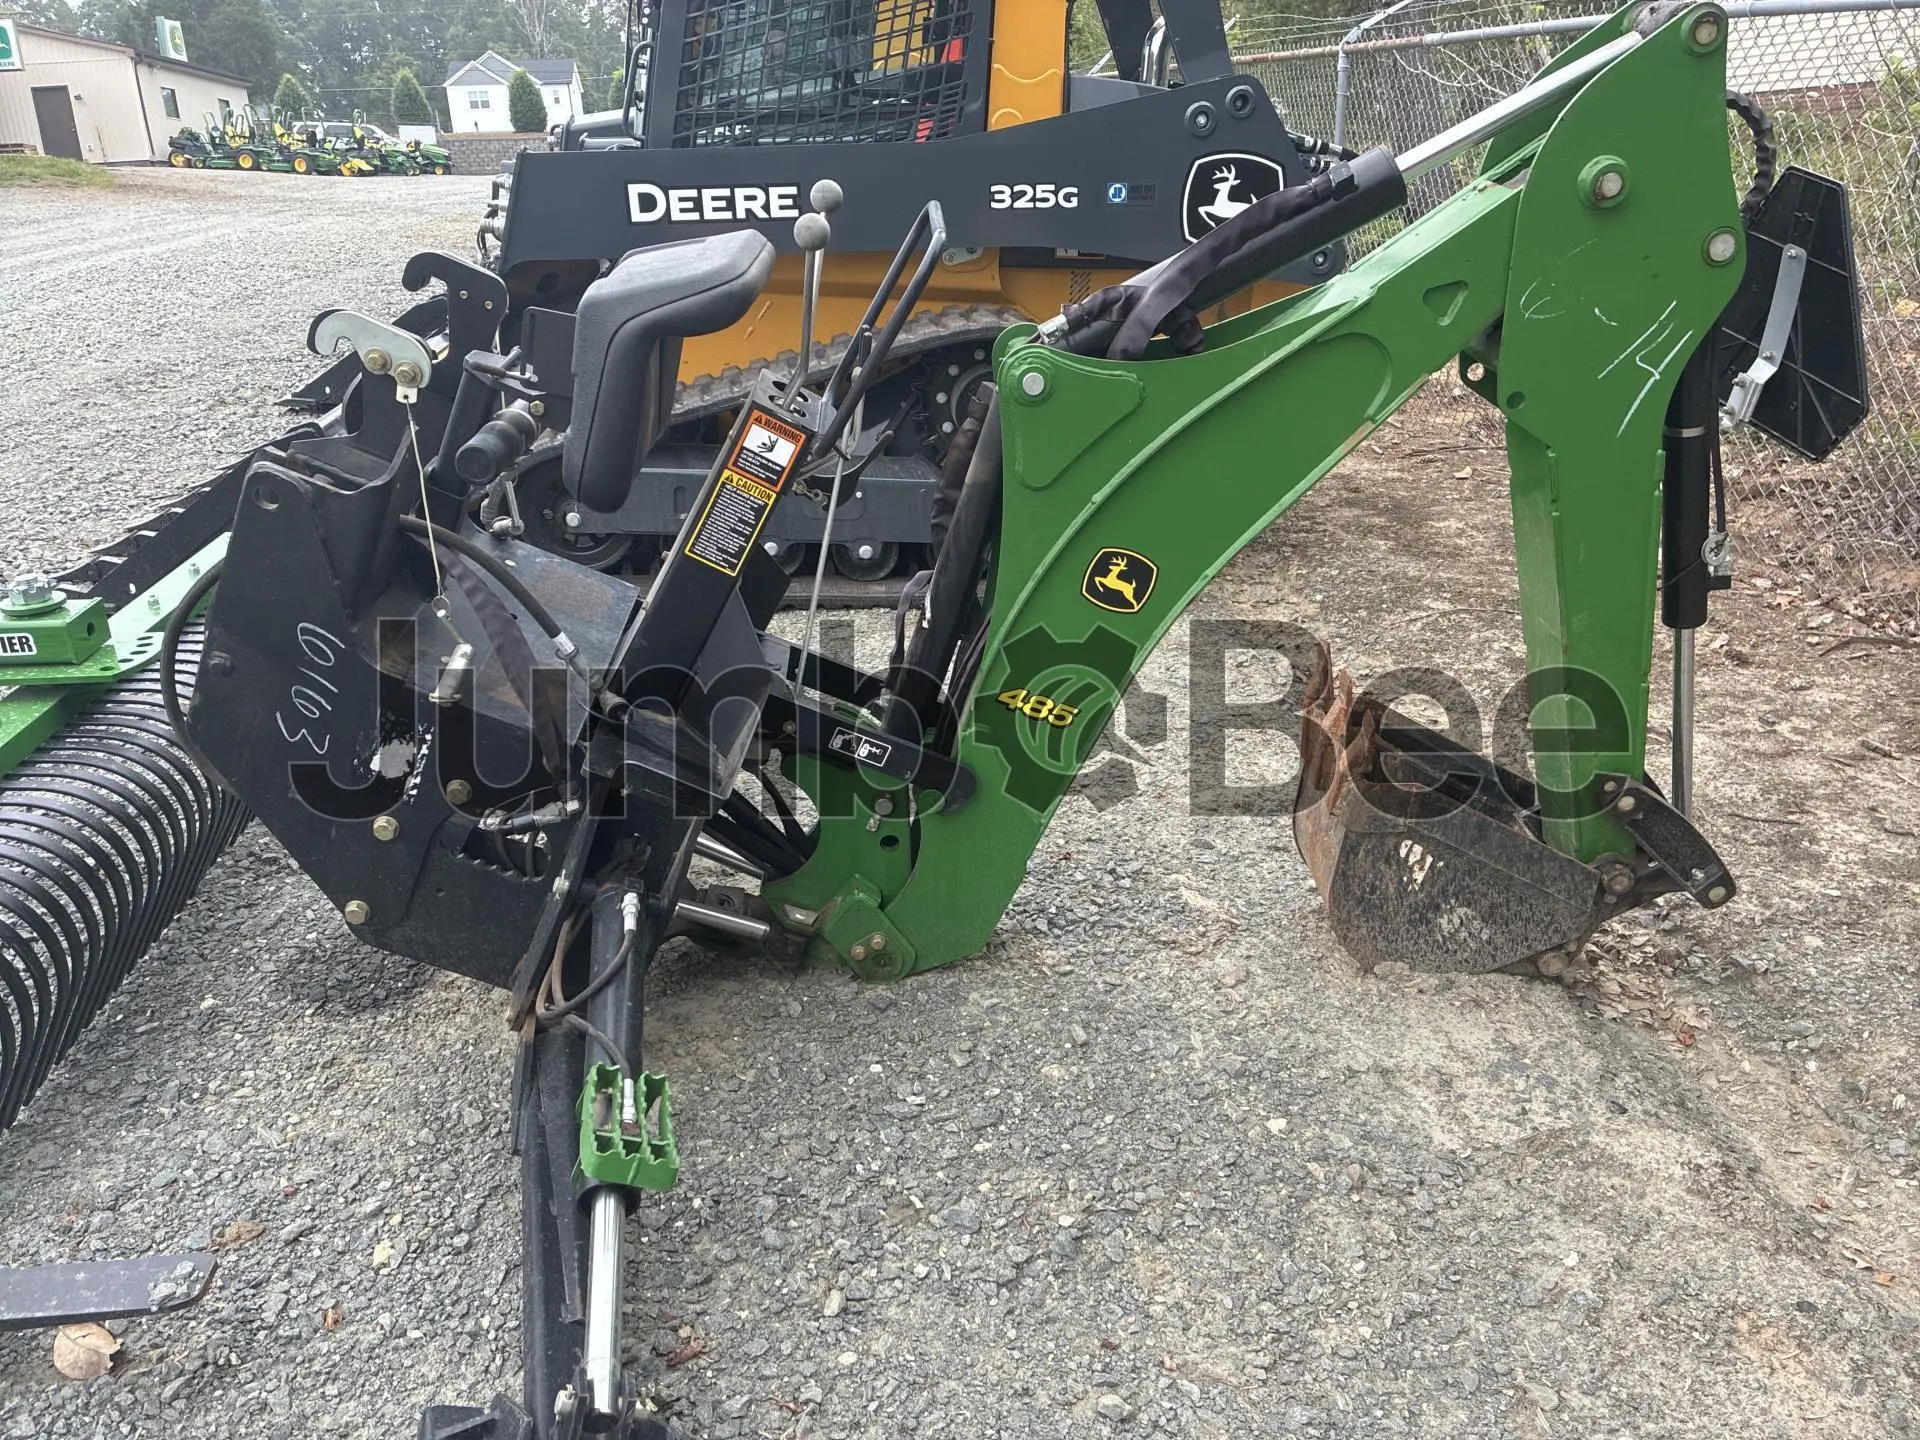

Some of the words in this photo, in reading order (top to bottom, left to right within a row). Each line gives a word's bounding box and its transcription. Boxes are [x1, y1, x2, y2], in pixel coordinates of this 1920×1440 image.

[627, 183, 800, 223] DEERE
[990, 184, 1079, 208] 325G
[762, 416, 802, 443] WARNING
[735, 478, 772, 502] CAUTION
[997, 688, 1080, 727] 485
